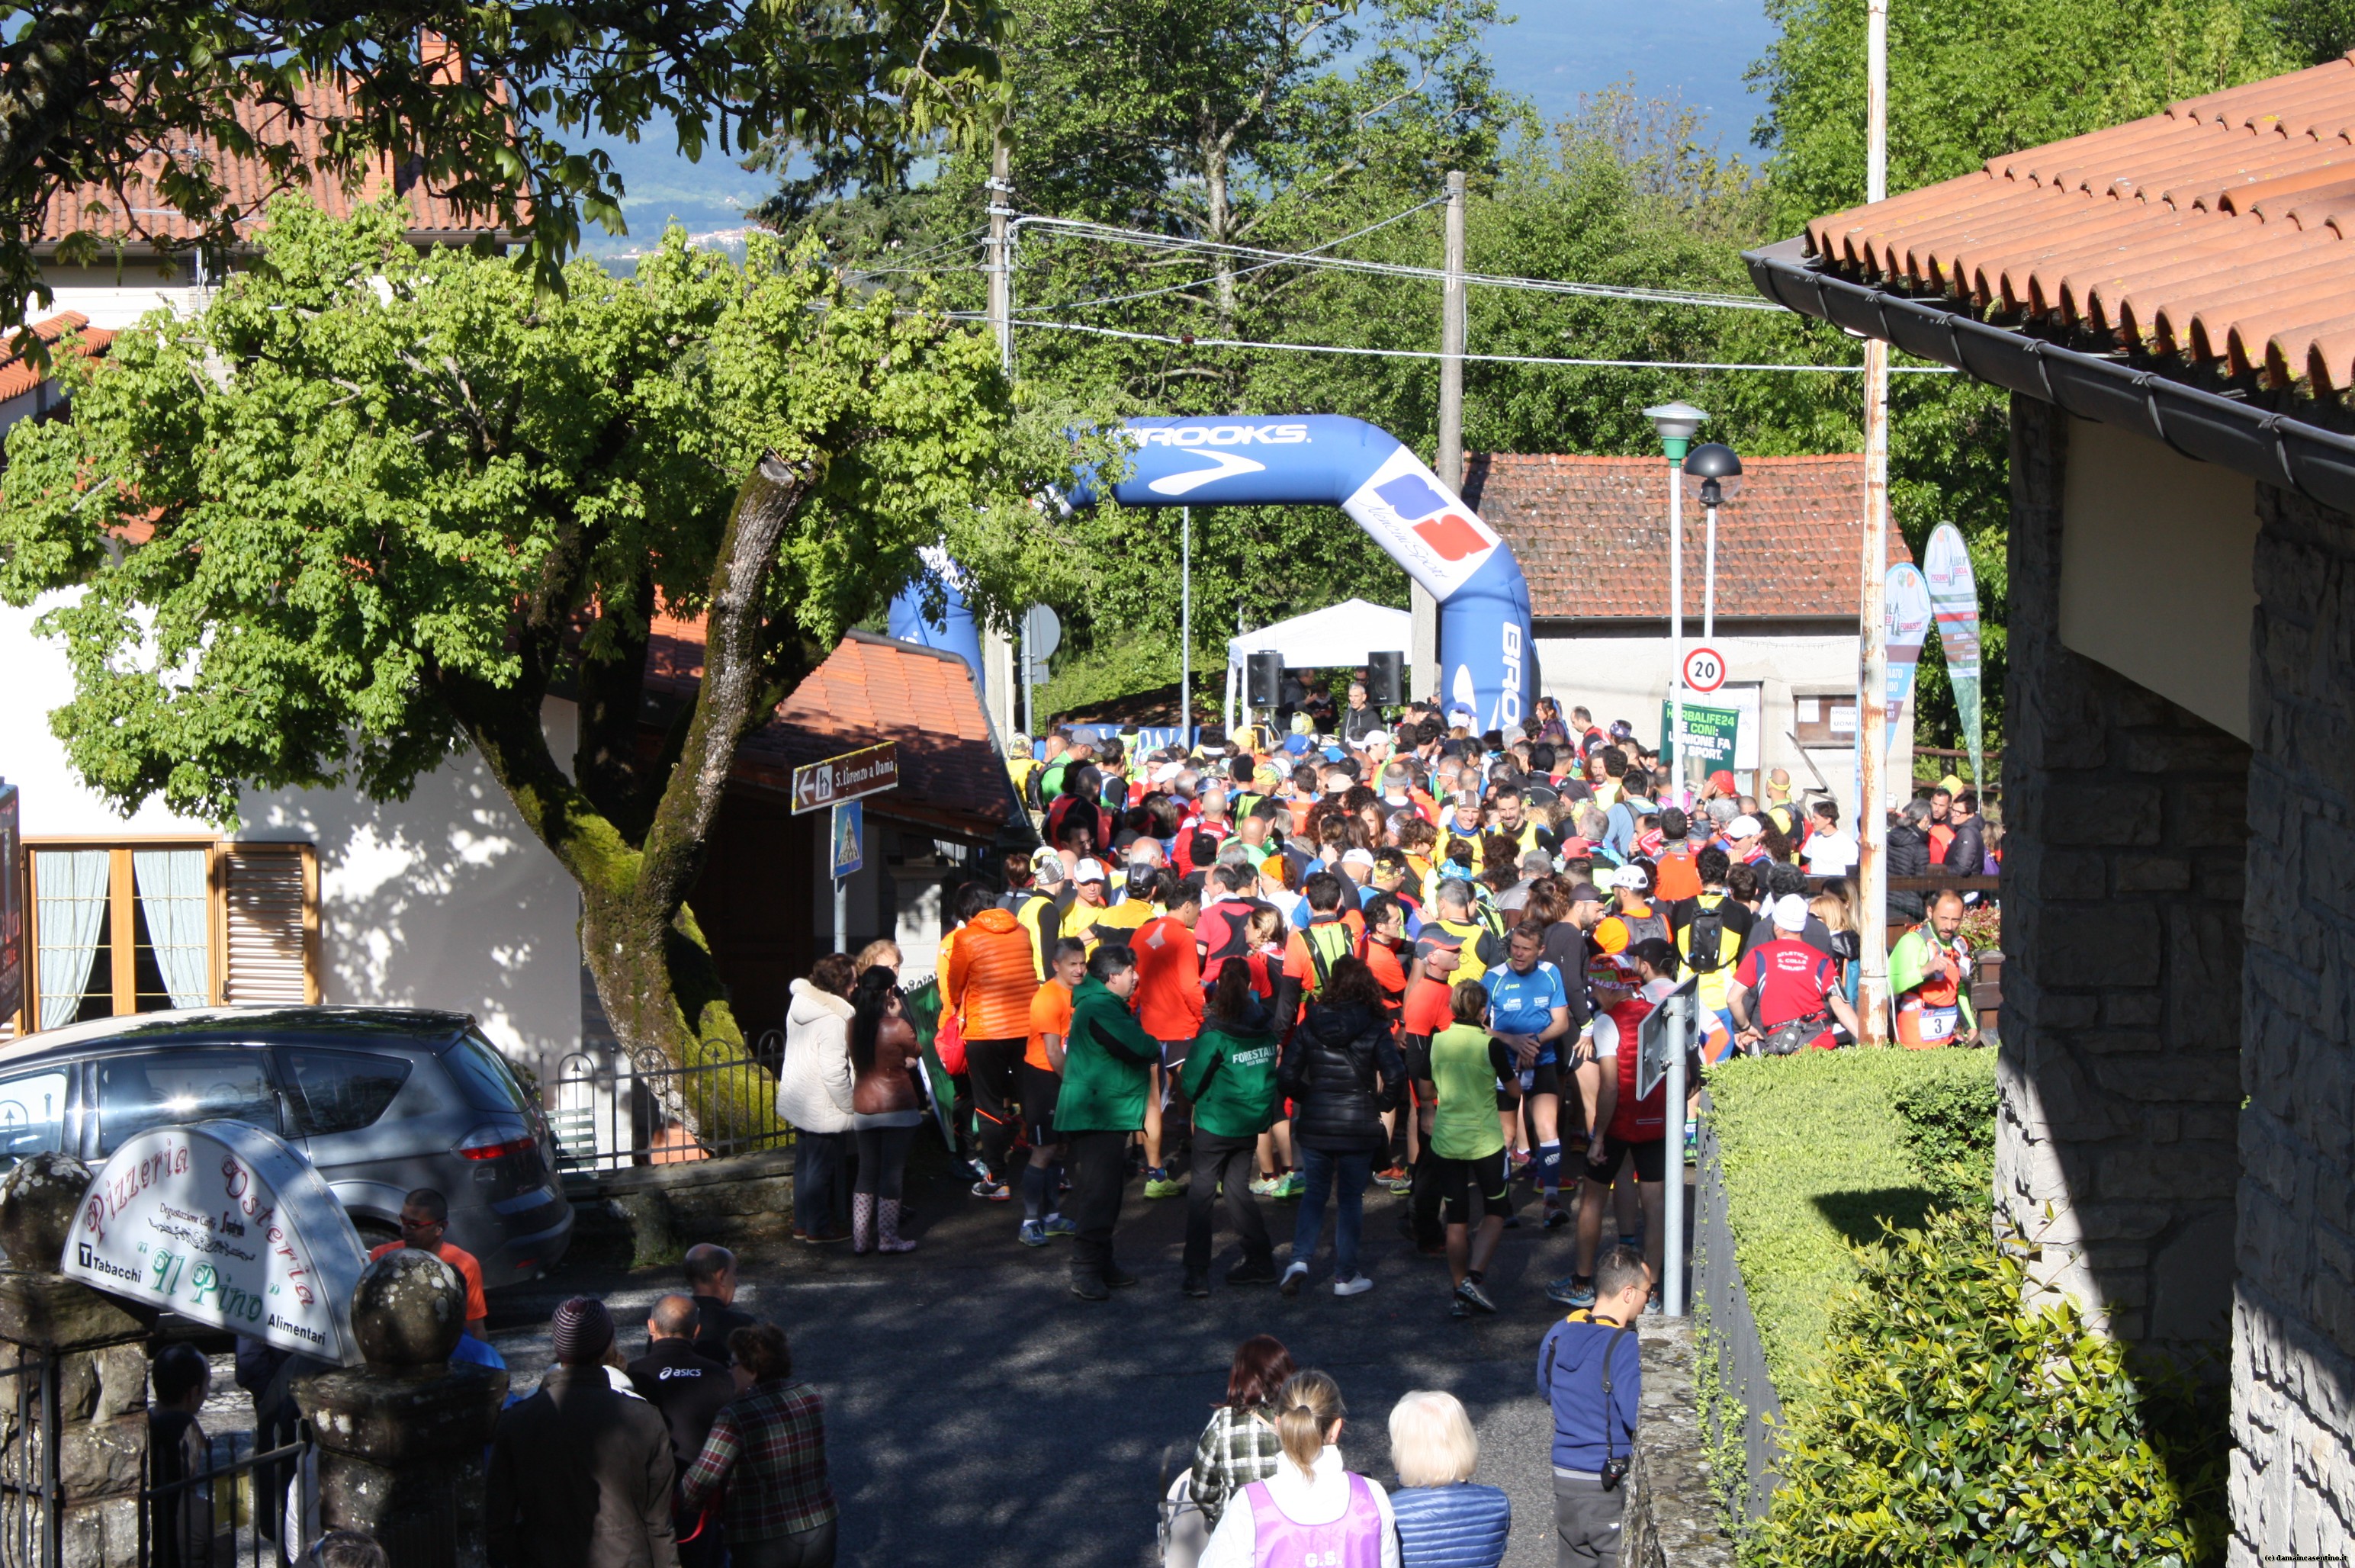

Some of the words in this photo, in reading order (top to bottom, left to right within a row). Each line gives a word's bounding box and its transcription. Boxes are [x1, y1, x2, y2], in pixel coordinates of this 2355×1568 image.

[1502, 622, 1521, 731] BRO
[1695, 661, 1715, 679] 20
[1666, 708, 1735, 727] HRBALIFE24
[1690, 722, 1719, 737] CONI:
[1688, 745, 1724, 760] SPORT.
[1717, 738, 1731, 750] FA
[843, 767, 868, 786] Lorenzo
[869, 766, 874, 778] a
[1934, 1018, 1942, 1033] 3
[85, 1138, 189, 1248] Pizzeria
[159, 1202, 199, 1220] Degustazione
[221, 1155, 315, 1309] Osteria
[93, 1257, 142, 1284] Tabacchi
[268, 1313, 326, 1346] Alimentari
[673, 1368, 702, 1377] asics
